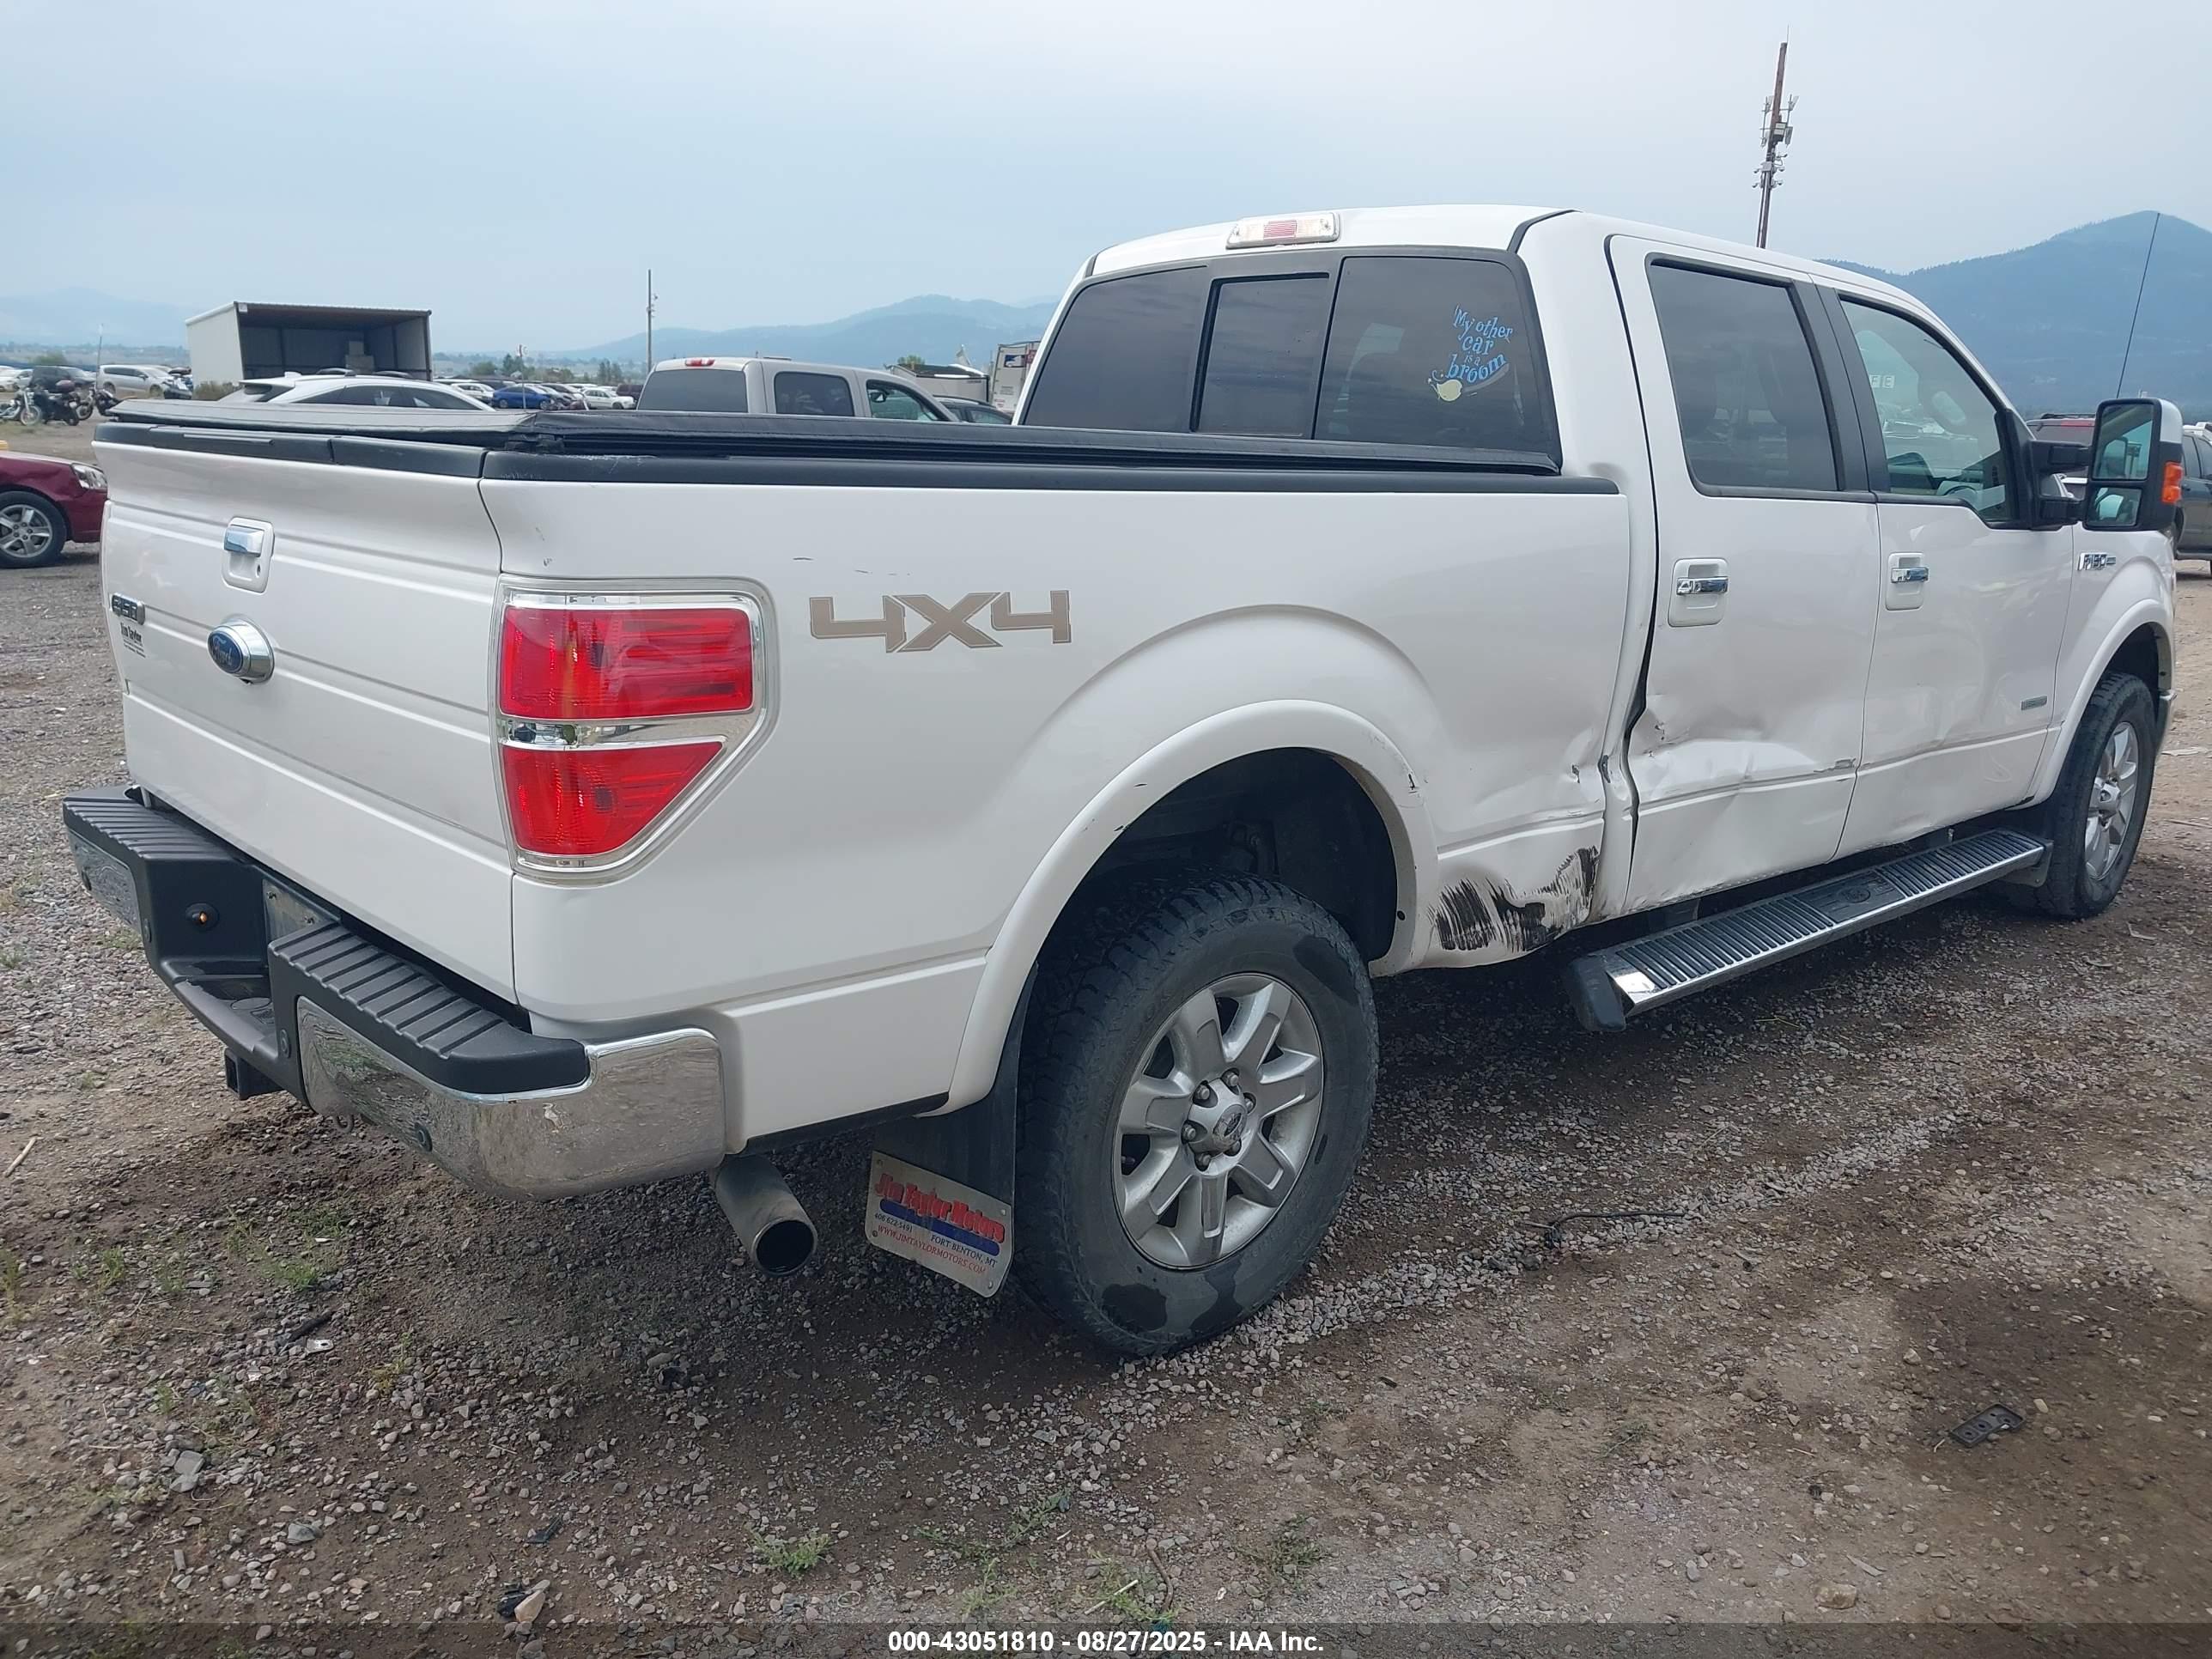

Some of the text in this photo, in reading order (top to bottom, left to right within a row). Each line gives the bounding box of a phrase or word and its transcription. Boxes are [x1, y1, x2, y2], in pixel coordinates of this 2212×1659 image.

[1453, 308, 1513, 341] My other
[1462, 336, 1494, 355] car
[1464, 351, 1473, 362] is
[1445, 354, 1506, 383] broom
[874, 1173, 1005, 1243] Jim Taylor Motors
[931, 1234, 951, 1248] FORT
[986, 1257, 998, 1267] MT
